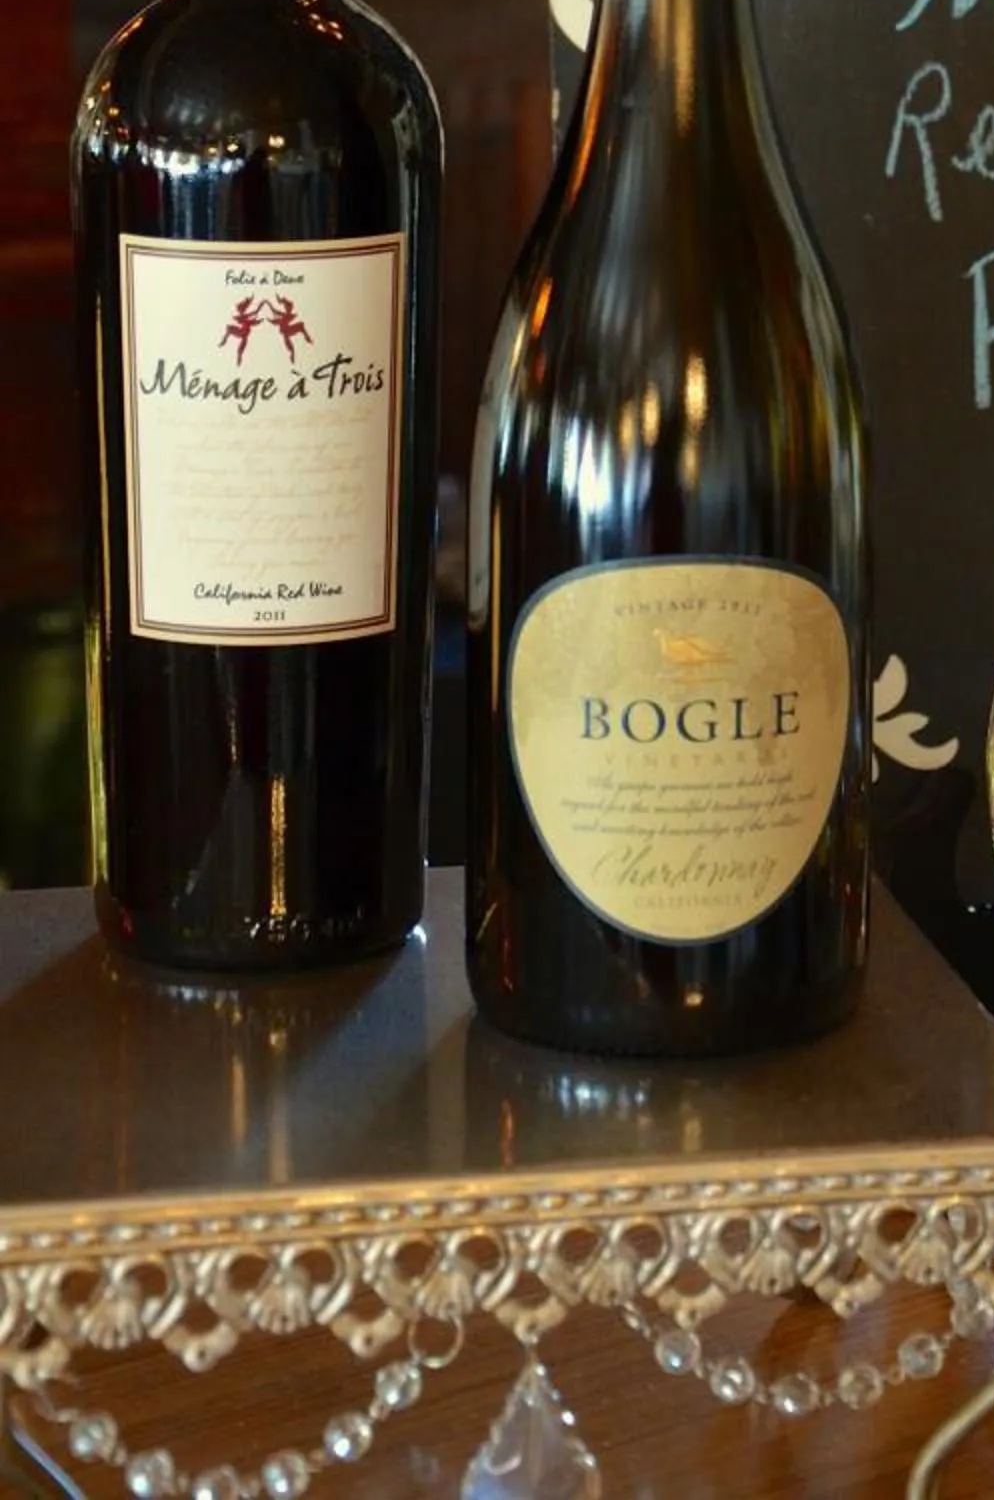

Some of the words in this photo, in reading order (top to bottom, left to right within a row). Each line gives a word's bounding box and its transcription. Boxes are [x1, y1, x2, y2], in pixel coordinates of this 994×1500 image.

[225, 269, 256, 286] Folie
[140, 358, 278, 415] Ménage
[287, 370, 310, 400] à
[312, 353, 385, 399] Trois
[193, 582, 273, 606] California
[276, 583, 306, 600] Red
[309, 581, 344, 598] Wine
[254, 610, 286, 622] 2011
[580, 689, 801, 744] BOGLE
